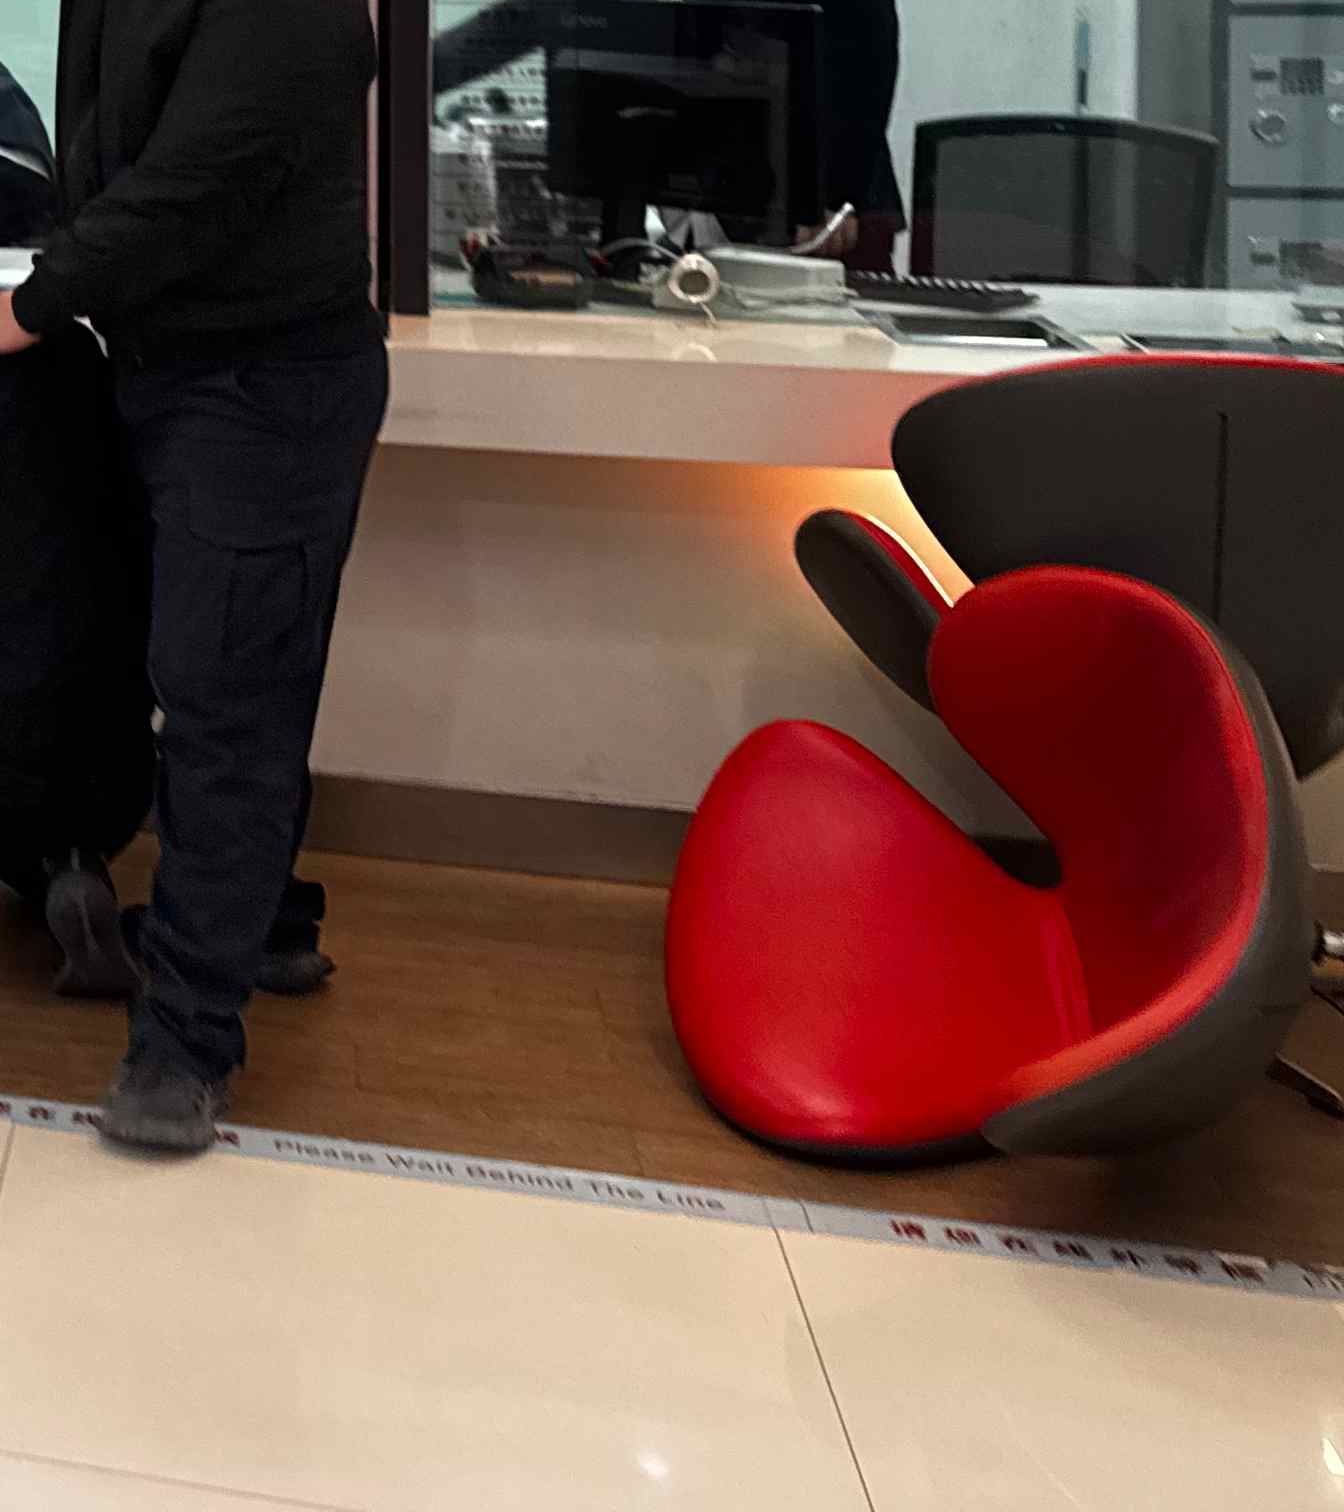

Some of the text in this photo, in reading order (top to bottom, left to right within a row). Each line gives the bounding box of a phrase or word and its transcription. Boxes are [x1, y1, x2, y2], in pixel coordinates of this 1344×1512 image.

[273, 1136, 376, 1168] Please
[384, 1151, 455, 1178] Wait
[587, 1177, 646, 1204] The
